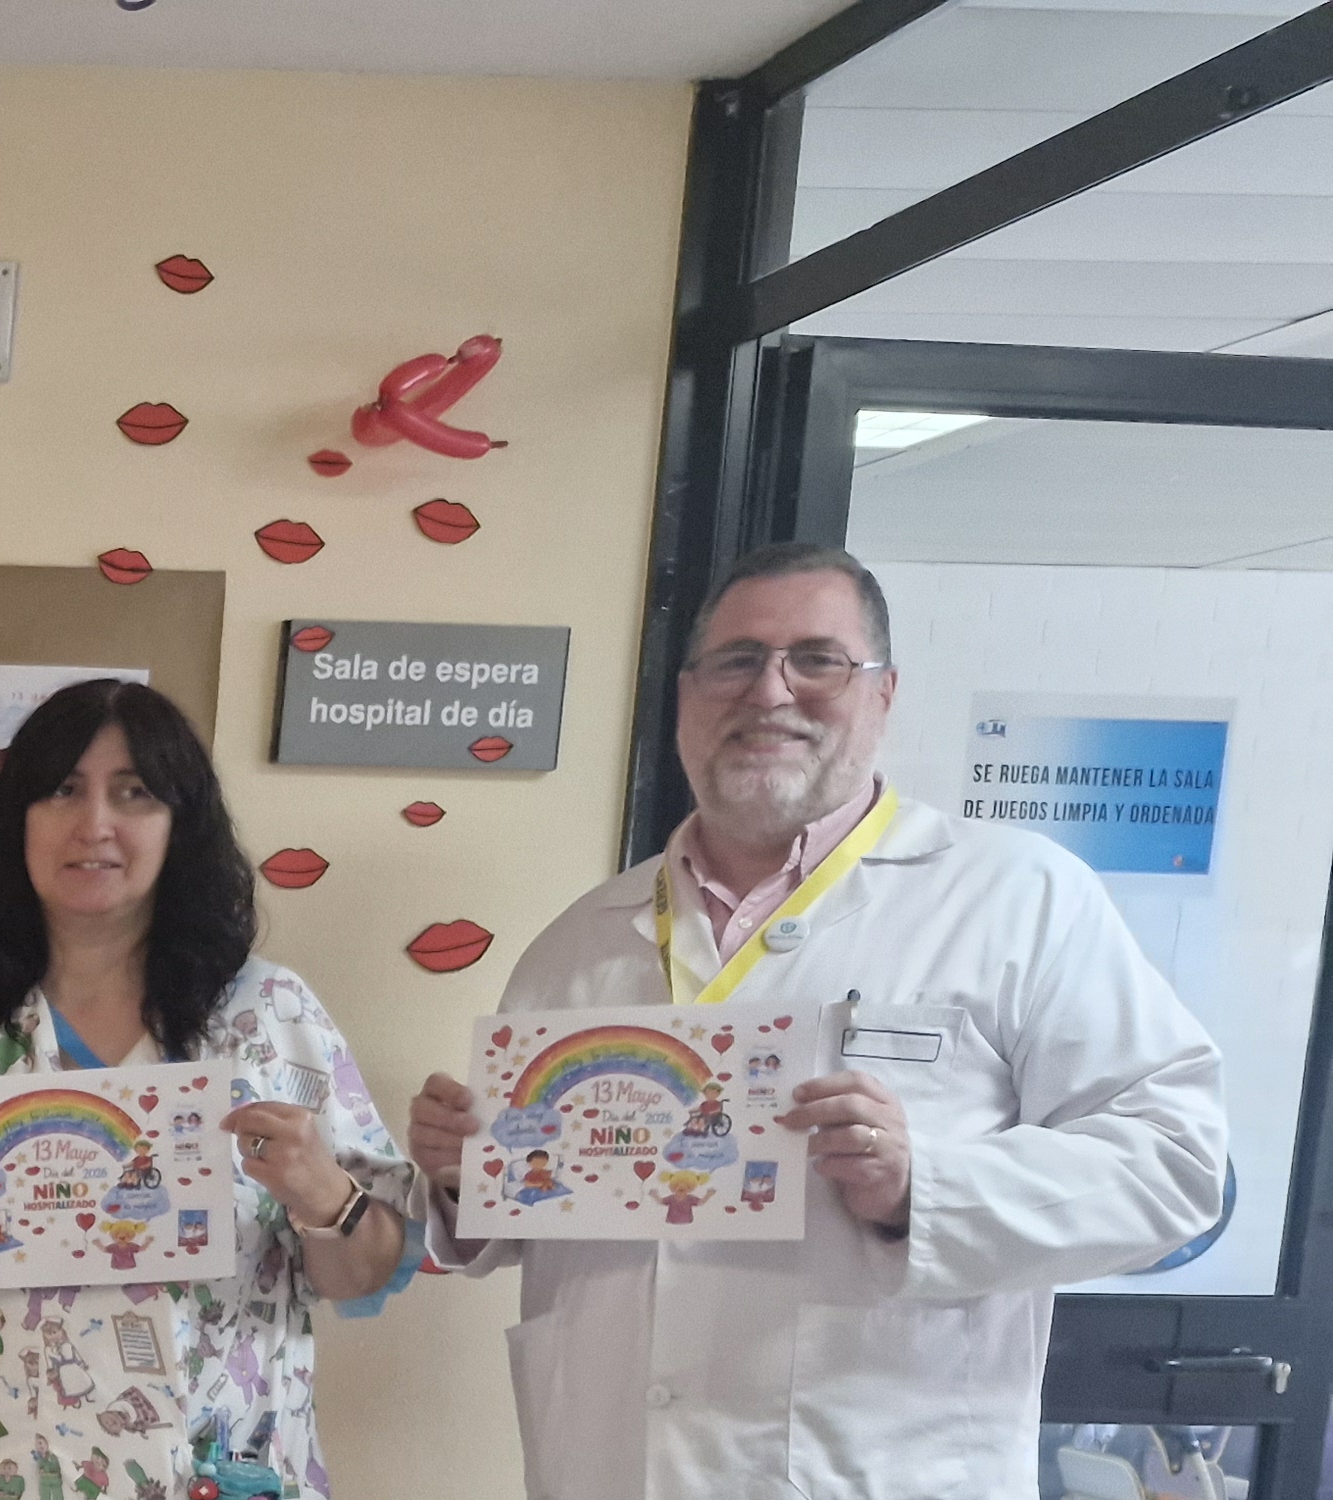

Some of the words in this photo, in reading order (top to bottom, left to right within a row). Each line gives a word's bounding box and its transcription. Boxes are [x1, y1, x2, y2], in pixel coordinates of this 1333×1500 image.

[312, 652, 379, 680] Sala
[388, 655, 426, 681] de
[436, 661, 539, 689] espera
[310, 697, 431, 730] hospital
[441, 701, 478, 727] de
[488, 700, 534, 728] día
[973, 764, 993, 783] SE
[999, 764, 1050, 785] RUEGA
[1055, 766, 1143, 787] MANTENER
[1149, 768, 1167, 788] LA
[1174, 770, 1213, 789] SALA
[963, 800, 983, 818] DE
[990, 801, 1048, 820] JUEGOS
[1053, 802, 1108, 822] LIMPIA
[1115, 803, 1124, 822] Y
[1130, 804, 1214, 825] ORDENADA
[591, 1080, 612, 1103] 13
[616, 1080, 663, 1112] Mayo
[32, 1140, 52, 1161] 13
[55, 1139, 99, 1168] Mayo
